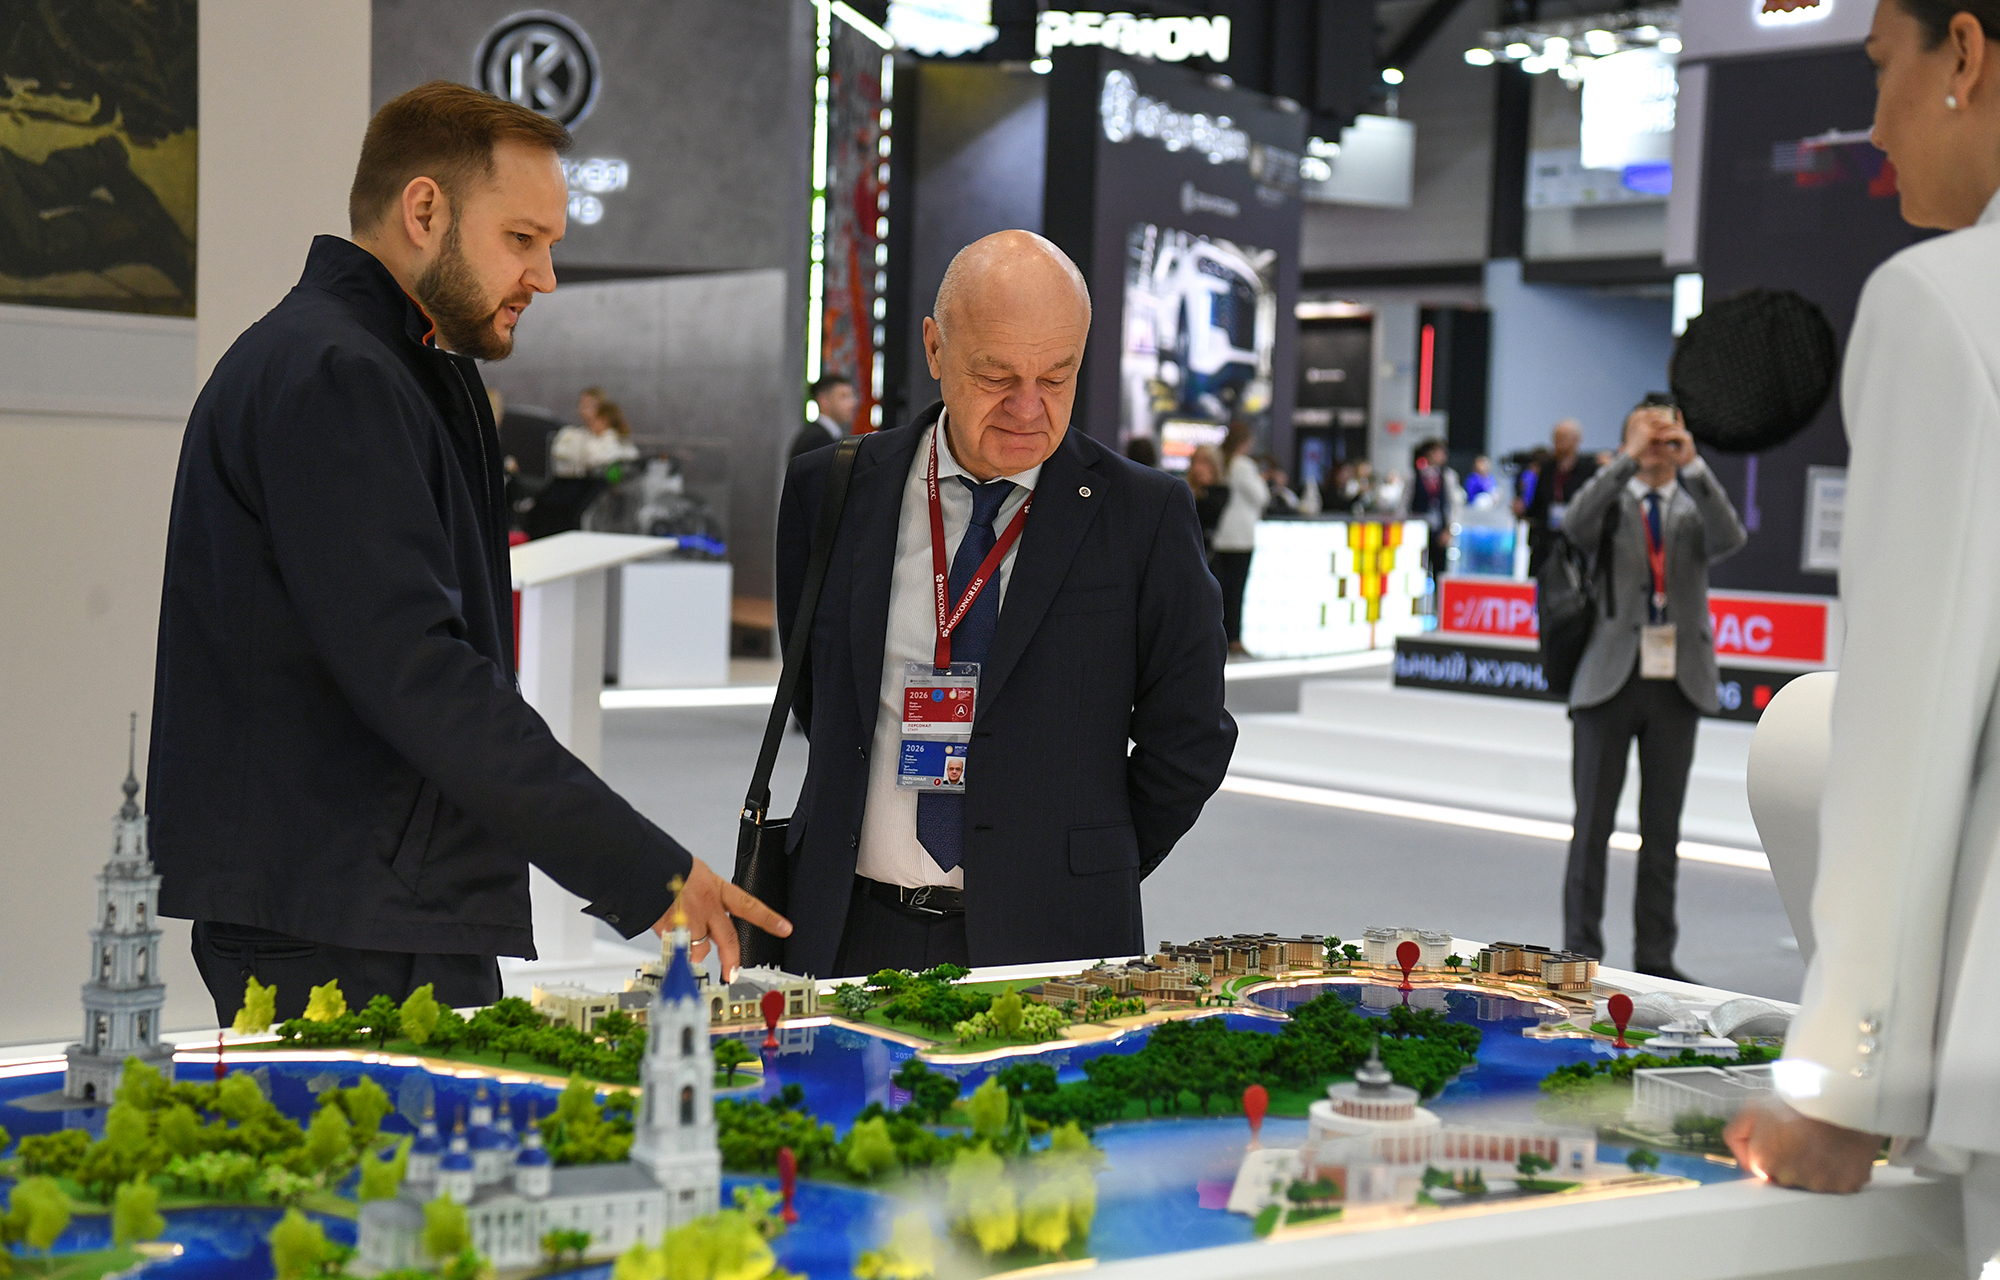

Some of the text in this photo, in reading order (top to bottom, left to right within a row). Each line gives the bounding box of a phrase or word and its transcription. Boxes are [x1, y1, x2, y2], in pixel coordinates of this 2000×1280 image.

[937, 583, 945, 634] ROSCONGR
[946, 577, 983, 629] ROSCONGRESS
[1709, 611, 1774, 654] АС
[1468, 658, 1550, 692] ЖУРН
[909, 691, 928, 699] 2026
[957, 705, 965, 715] A
[906, 744, 925, 752] 2026
